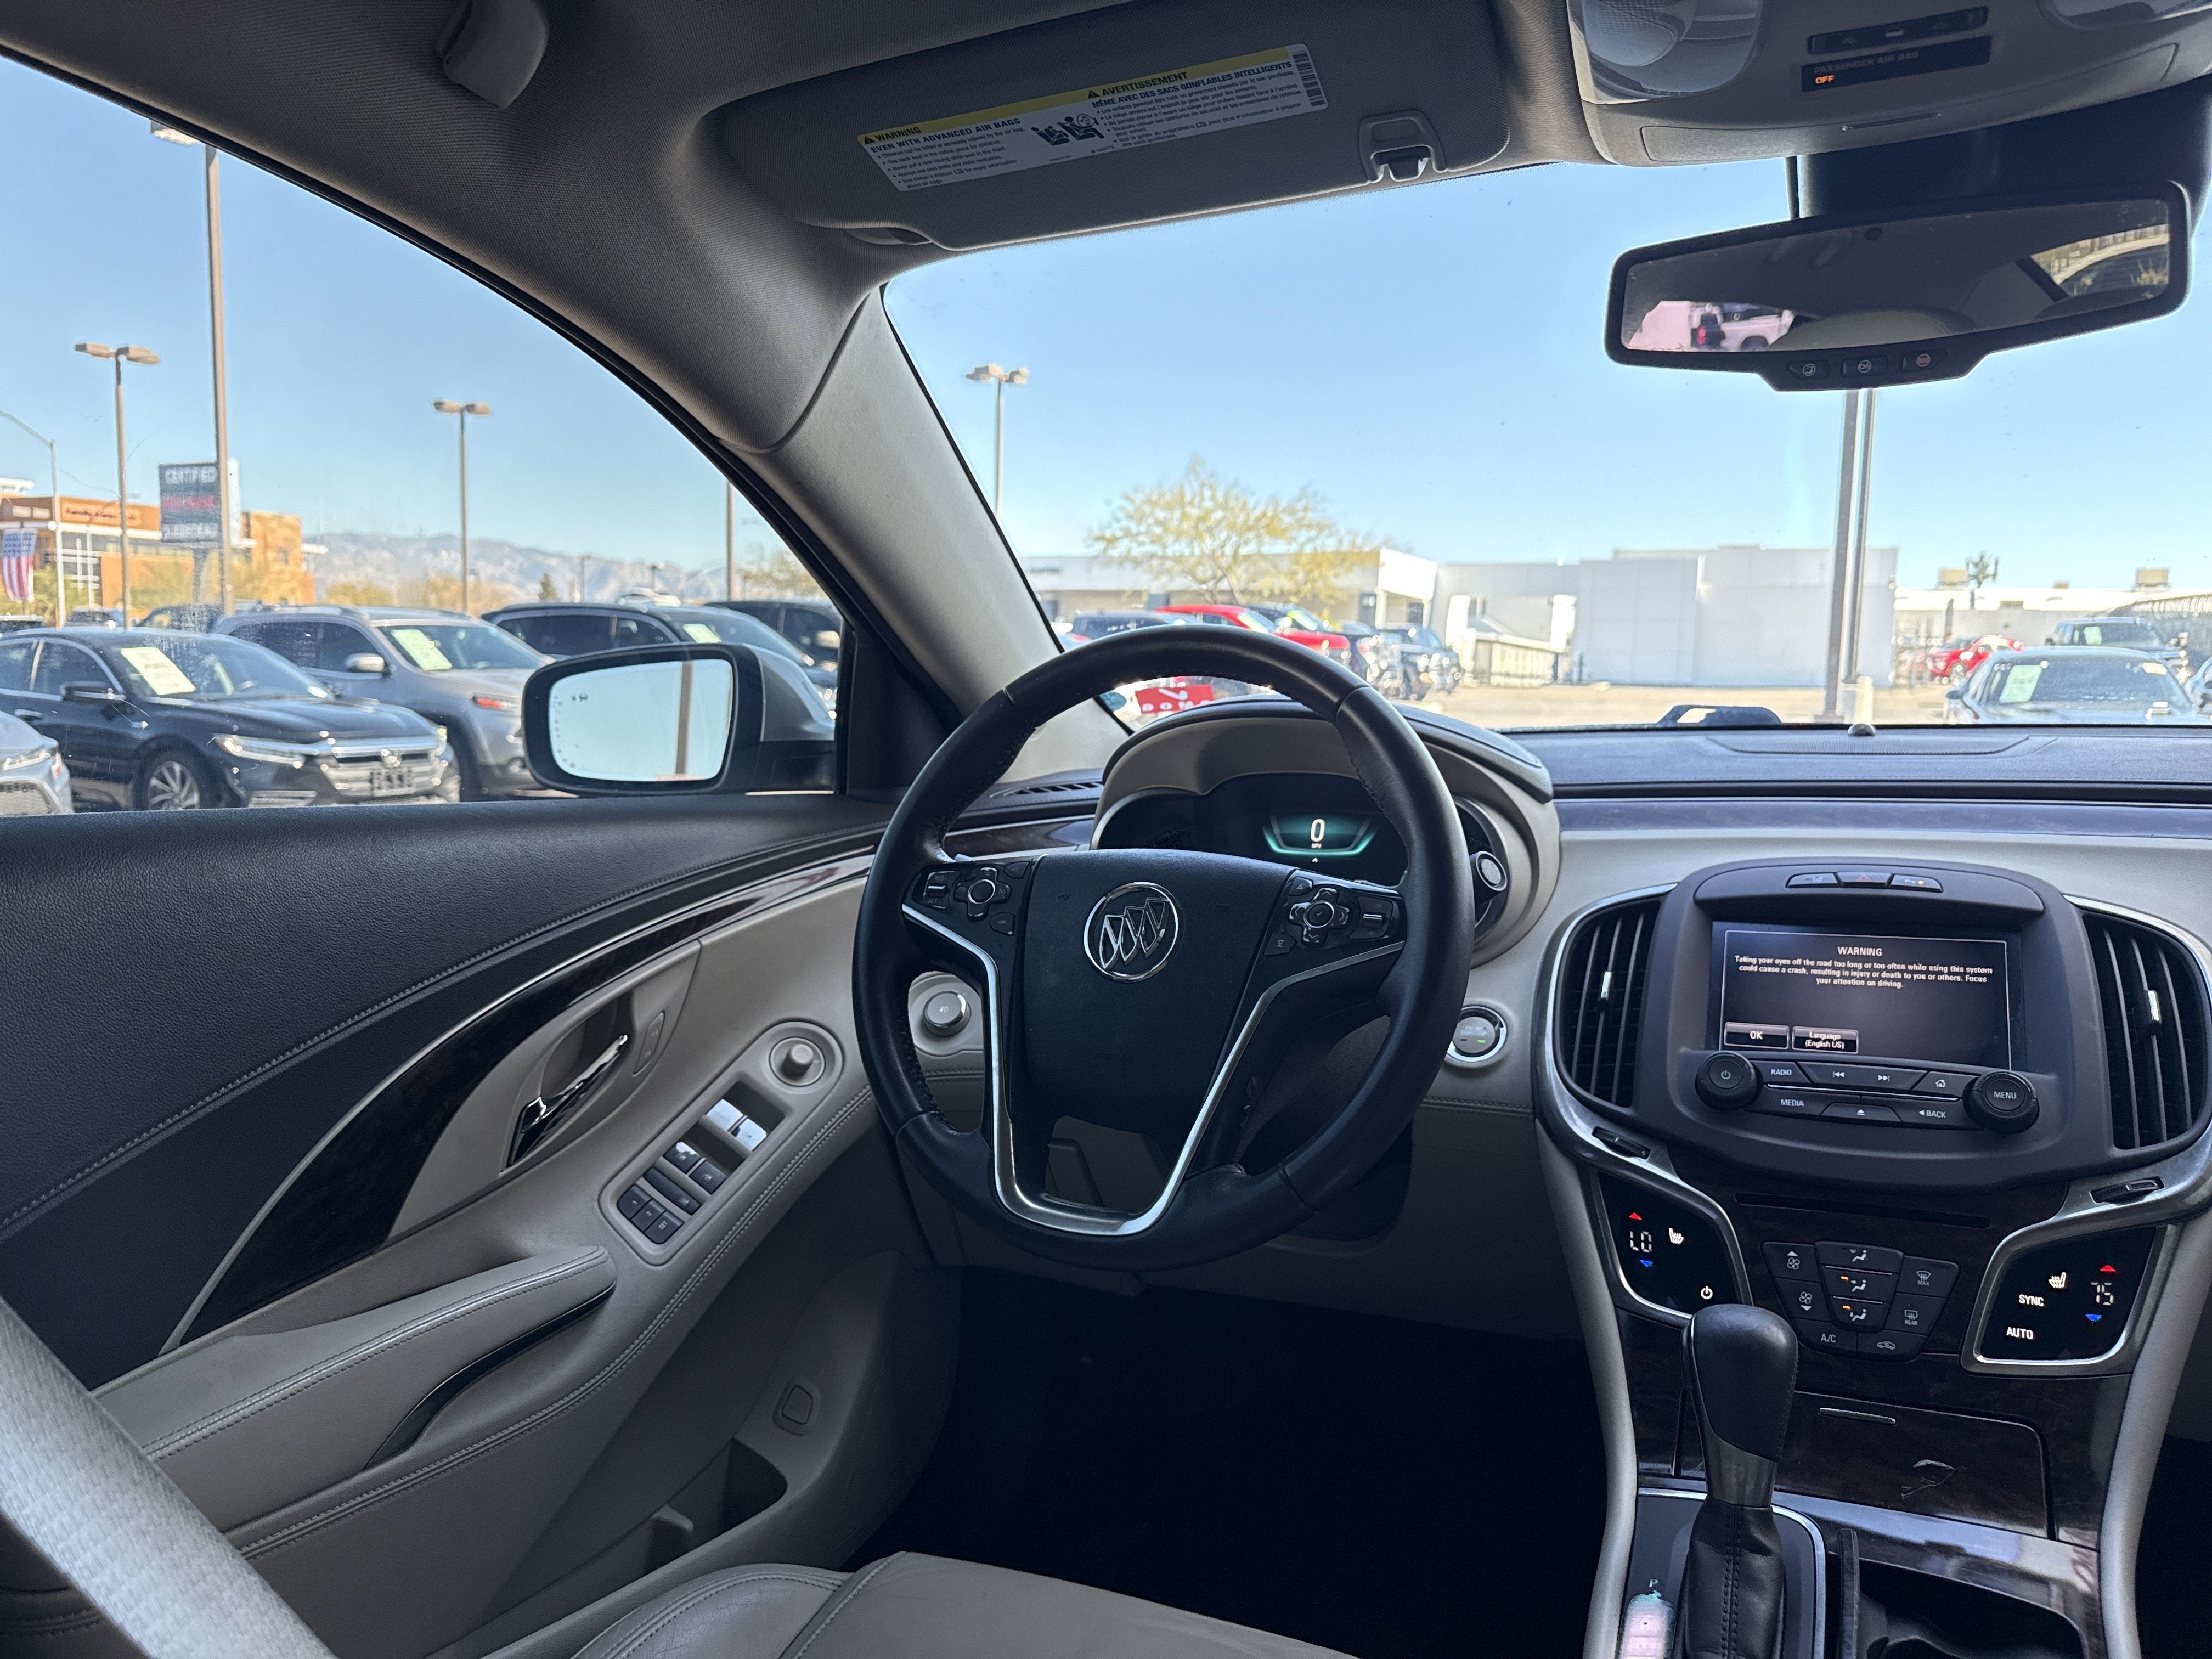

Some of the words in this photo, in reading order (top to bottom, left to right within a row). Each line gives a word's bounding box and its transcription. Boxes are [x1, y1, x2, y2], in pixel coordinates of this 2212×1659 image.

[1102, 72, 1188, 95] AVERTISSEMENT
[1815, 75, 1835, 84] OFF
[1092, 98, 1116, 108] MÊME
[1118, 93, 1138, 102] AVEC
[1157, 85, 1178, 94] SACS
[1181, 74, 1233, 89] GONFLABLES
[1234, 62, 1291, 78] INTELLIGENTS
[871, 144, 895, 153] EVEN
[896, 138, 921, 148] WITH
[922, 128, 972, 142] ADVANCED
[994, 119, 1020, 128] BAGS
[875, 127, 922, 141] WARNING
[1311, 819, 1325, 842] 0
[1837, 946, 1882, 956] WARNING
[1735, 955, 1756, 964] Taking
[1847, 961, 1862, 969] long
[1928, 964, 1948, 973] using
[1810, 968, 1840, 977] resulting
[1850, 970, 1870, 978] injury
[1877, 980, 1903, 989] driving.
[1750, 1031, 1763, 1040] OK
[1809, 1031, 1841, 1041] Language
[1805, 1040, 1831, 1048] (English
[1832, 1041, 1844, 1049] US)
[1994, 1091, 2017, 1099] MENU
[1780, 1099, 1804, 1107] MEDIA
[1926, 1110, 1946, 1119] BACK
[658, 1220, 668, 1229] SET
[2090, 1282, 2113, 1306] 75
[2018, 1294, 2044, 1307] SYNC
[1820, 1333, 1836, 1344] A/C
[2006, 1327, 2034, 1340] AUTO
[1649, 1579, 1658, 1587] P
